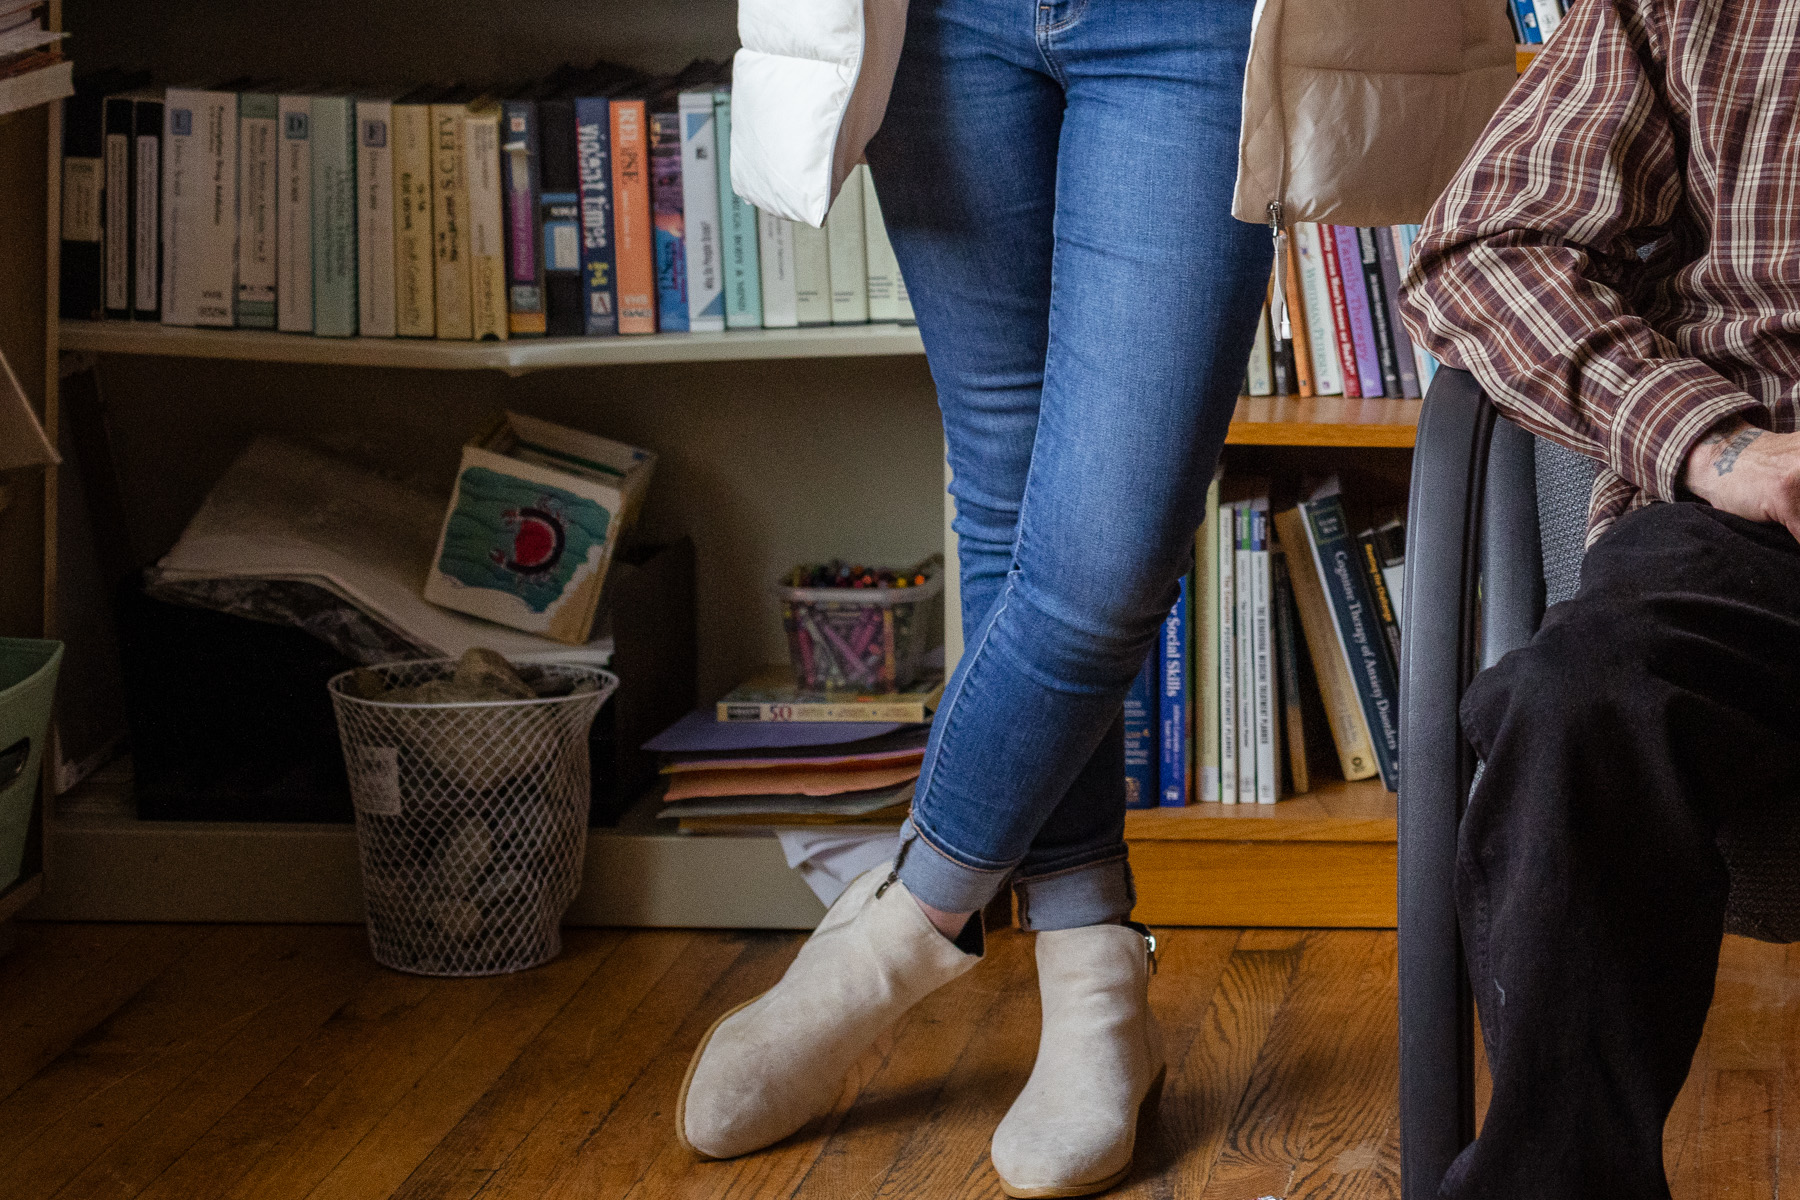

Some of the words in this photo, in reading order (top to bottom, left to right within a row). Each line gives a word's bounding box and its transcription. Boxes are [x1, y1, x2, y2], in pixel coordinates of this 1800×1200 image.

[578, 124, 607, 191] violent
[583, 196, 612, 249] times
[1348, 296, 1369, 363] Therapy
[1334, 550, 1355, 599] Cognitive
[1165, 617, 1181, 658] Social
[1347, 600, 1368, 647] Therapy
[1362, 647, 1374, 658] of
[1165, 661, 1181, 697] Skills
[1363, 659, 1383, 699] Anxiety
[769, 705, 793, 721] 50
[1376, 699, 1399, 750] Disorders
